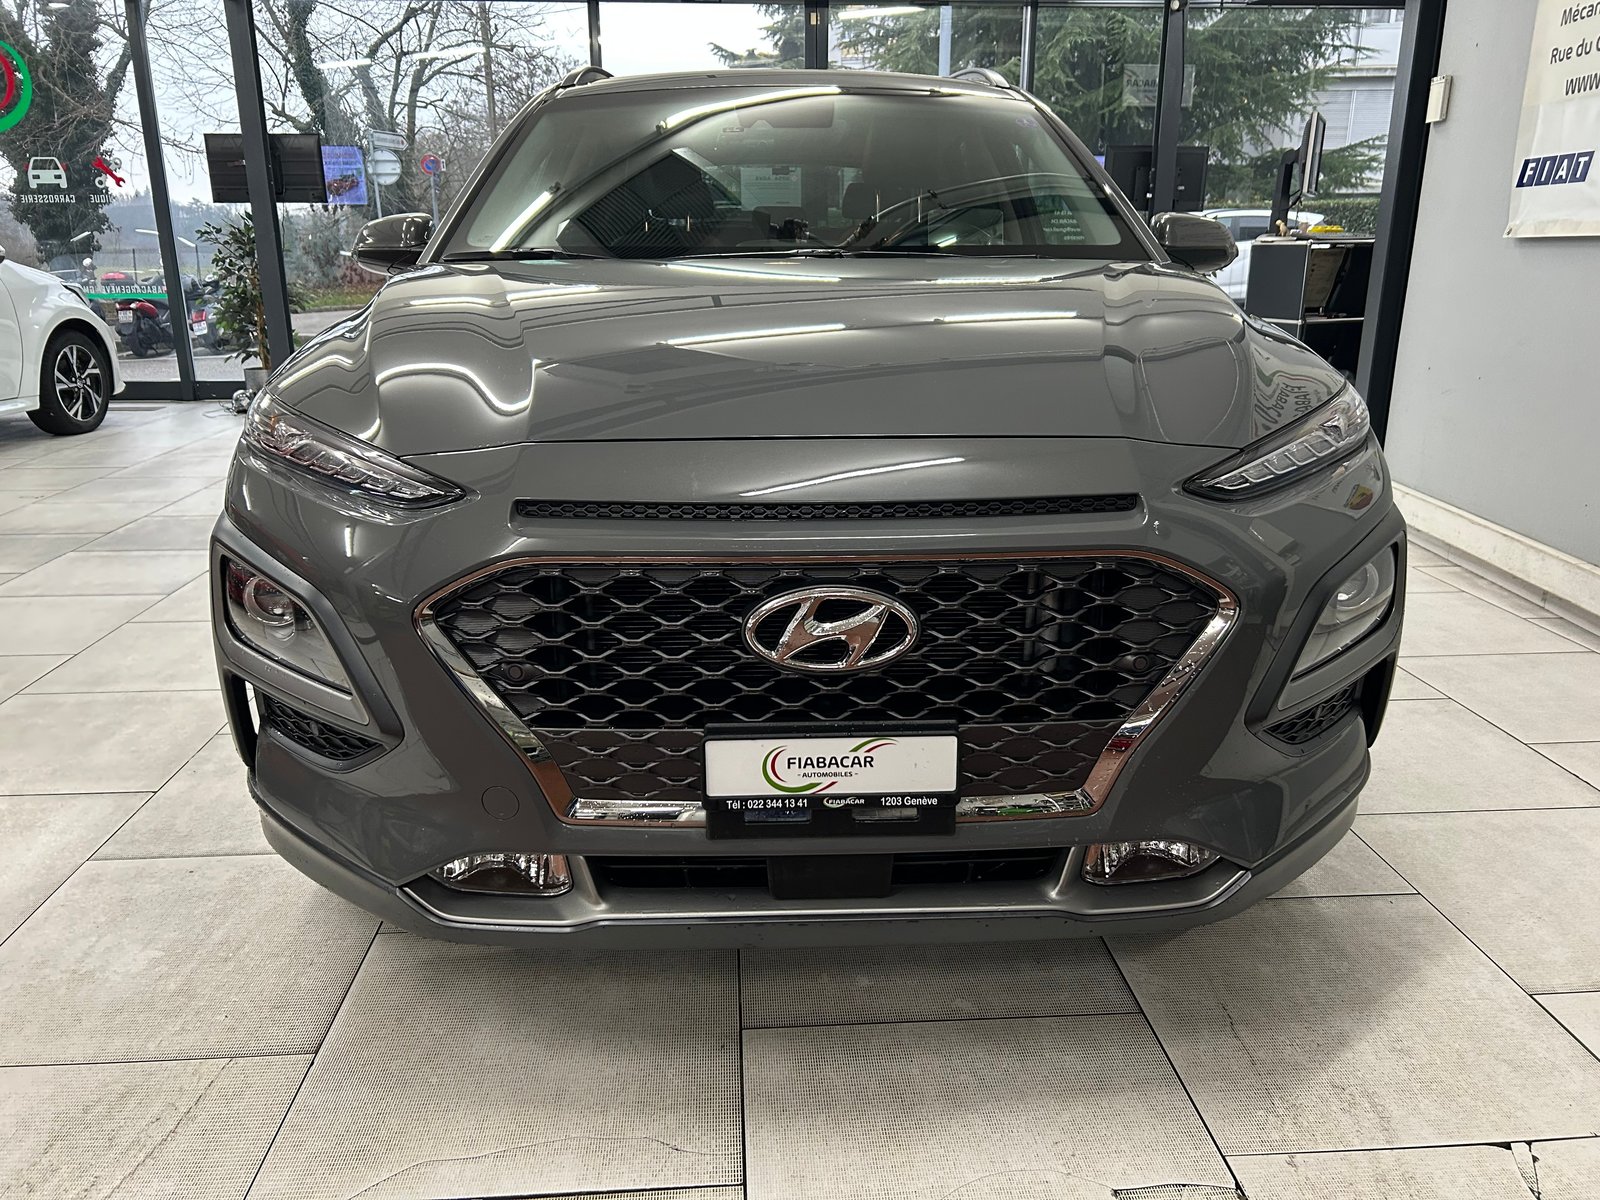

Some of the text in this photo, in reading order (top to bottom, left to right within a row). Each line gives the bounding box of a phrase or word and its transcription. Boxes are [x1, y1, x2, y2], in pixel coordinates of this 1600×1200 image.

[1550, 47, 1573, 64] Rue
[1576, 38, 1593, 57] du
[1522, 155, 1590, 185] FIAT
[786, 755, 875, 769] FIABACAR
[726, 799, 741, 810] Tél
[747, 799, 764, 809] 022
[766, 798, 783, 809] 344
[784, 798, 796, 808] 13
[797, 798, 808, 808] 41
[880, 796, 938, 806] 1203 Genève
